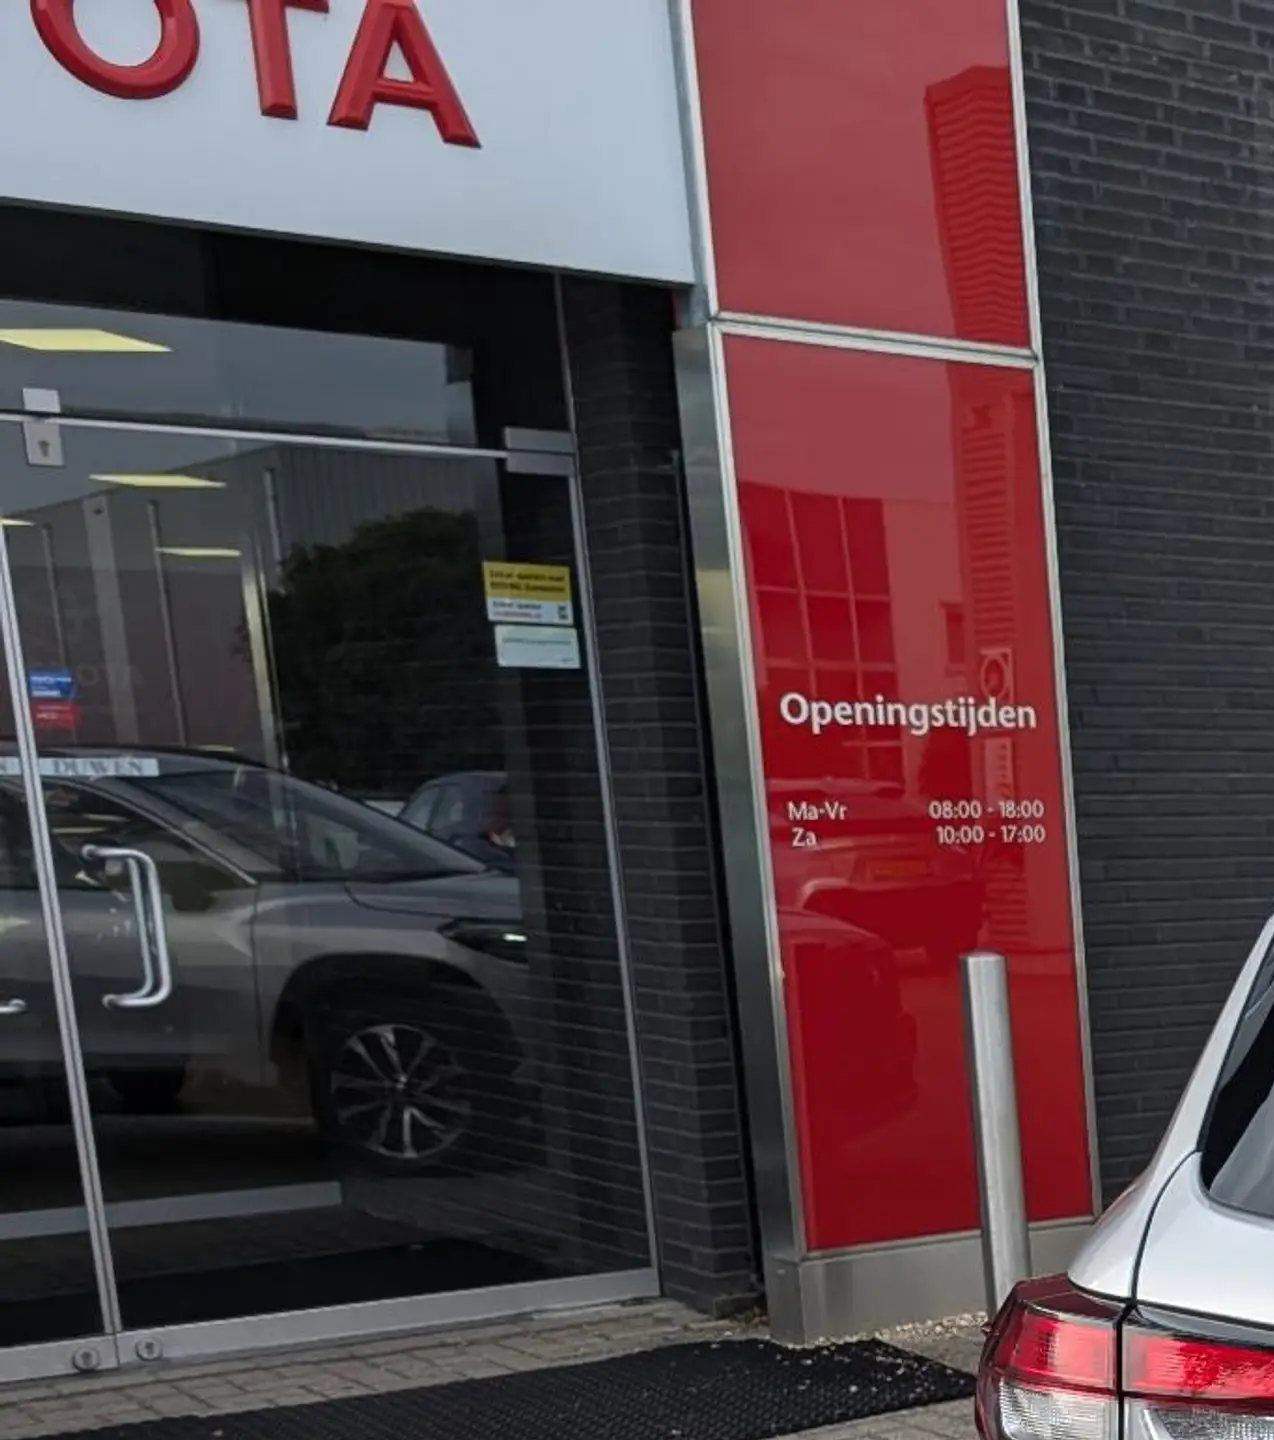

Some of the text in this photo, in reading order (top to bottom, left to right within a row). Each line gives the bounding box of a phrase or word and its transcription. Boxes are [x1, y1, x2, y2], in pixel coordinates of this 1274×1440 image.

[780, 692, 1037, 736] Openingstijden
[787, 801, 848, 821] Ma-Vr
[928, 801, 982, 819] 08:00
[999, 799, 1045, 819] 18:00
[792, 827, 817, 848] Za
[936, 826, 985, 844] 10:00
[1001, 825, 1046, 843] 17:00
